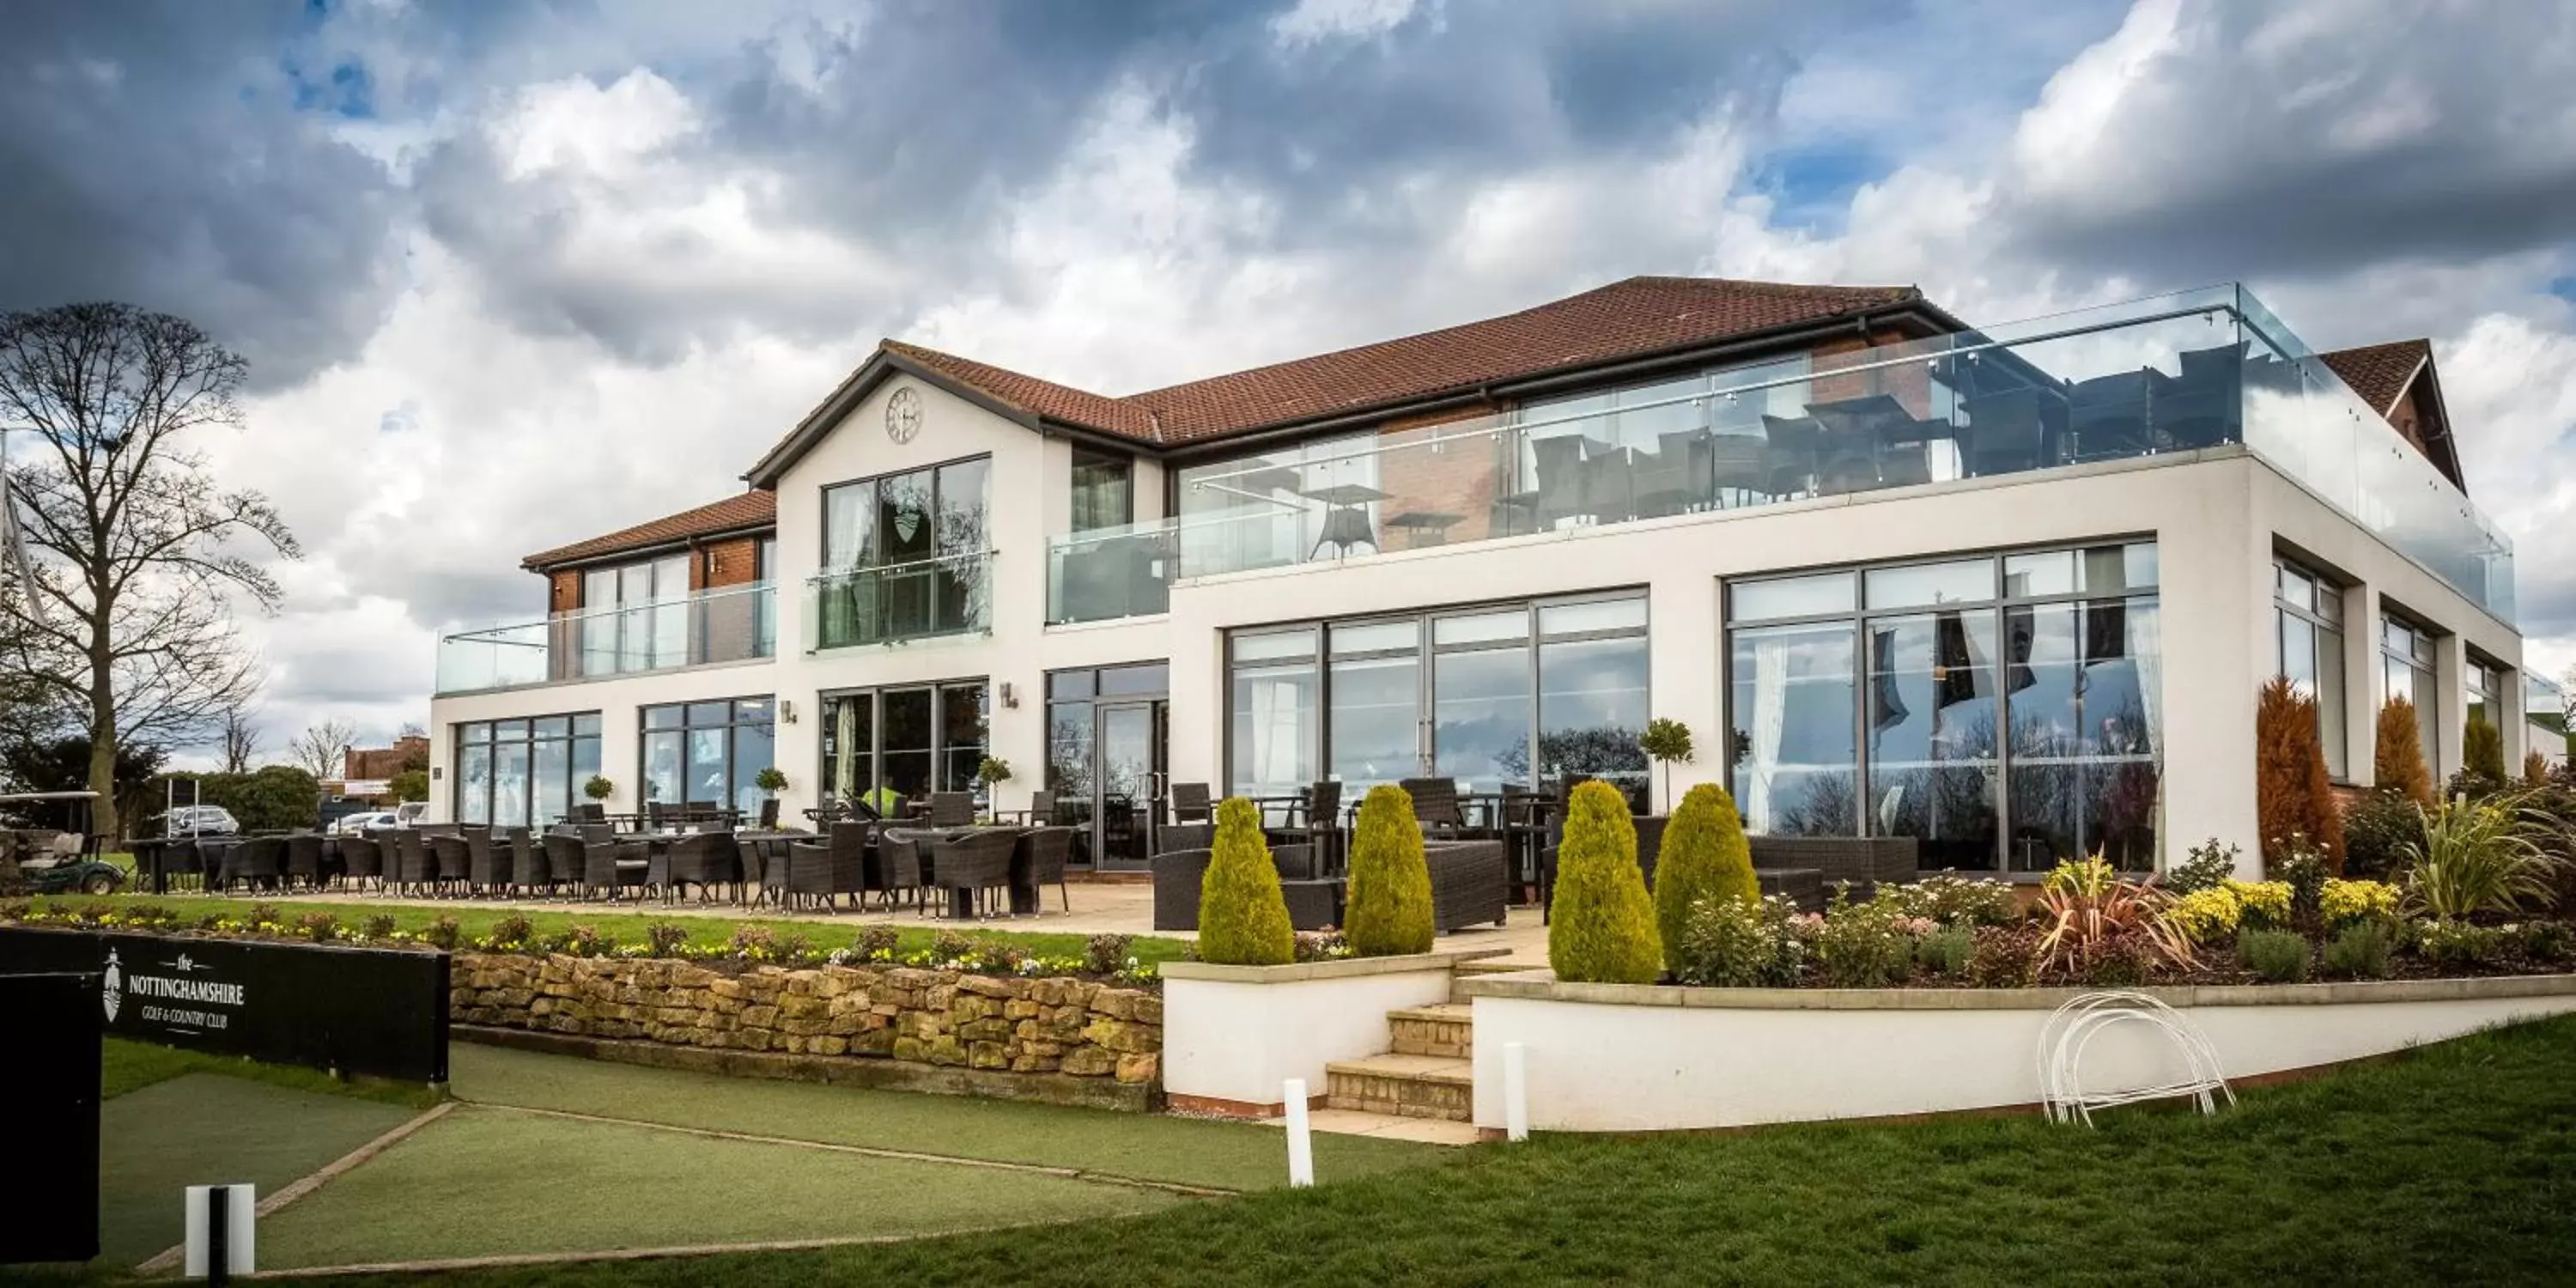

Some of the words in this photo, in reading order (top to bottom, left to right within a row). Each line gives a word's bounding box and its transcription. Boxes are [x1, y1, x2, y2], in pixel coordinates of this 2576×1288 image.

[177, 953, 193, 971] the
[130, 975, 245, 1005] NOTTINGHAMSHIRE
[142, 1005, 162, 1021] GOLF
[162, 1008, 170, 1022] &
[170, 1009, 206, 1027] COUNTRY
[207, 1012, 228, 1030] CLUB
